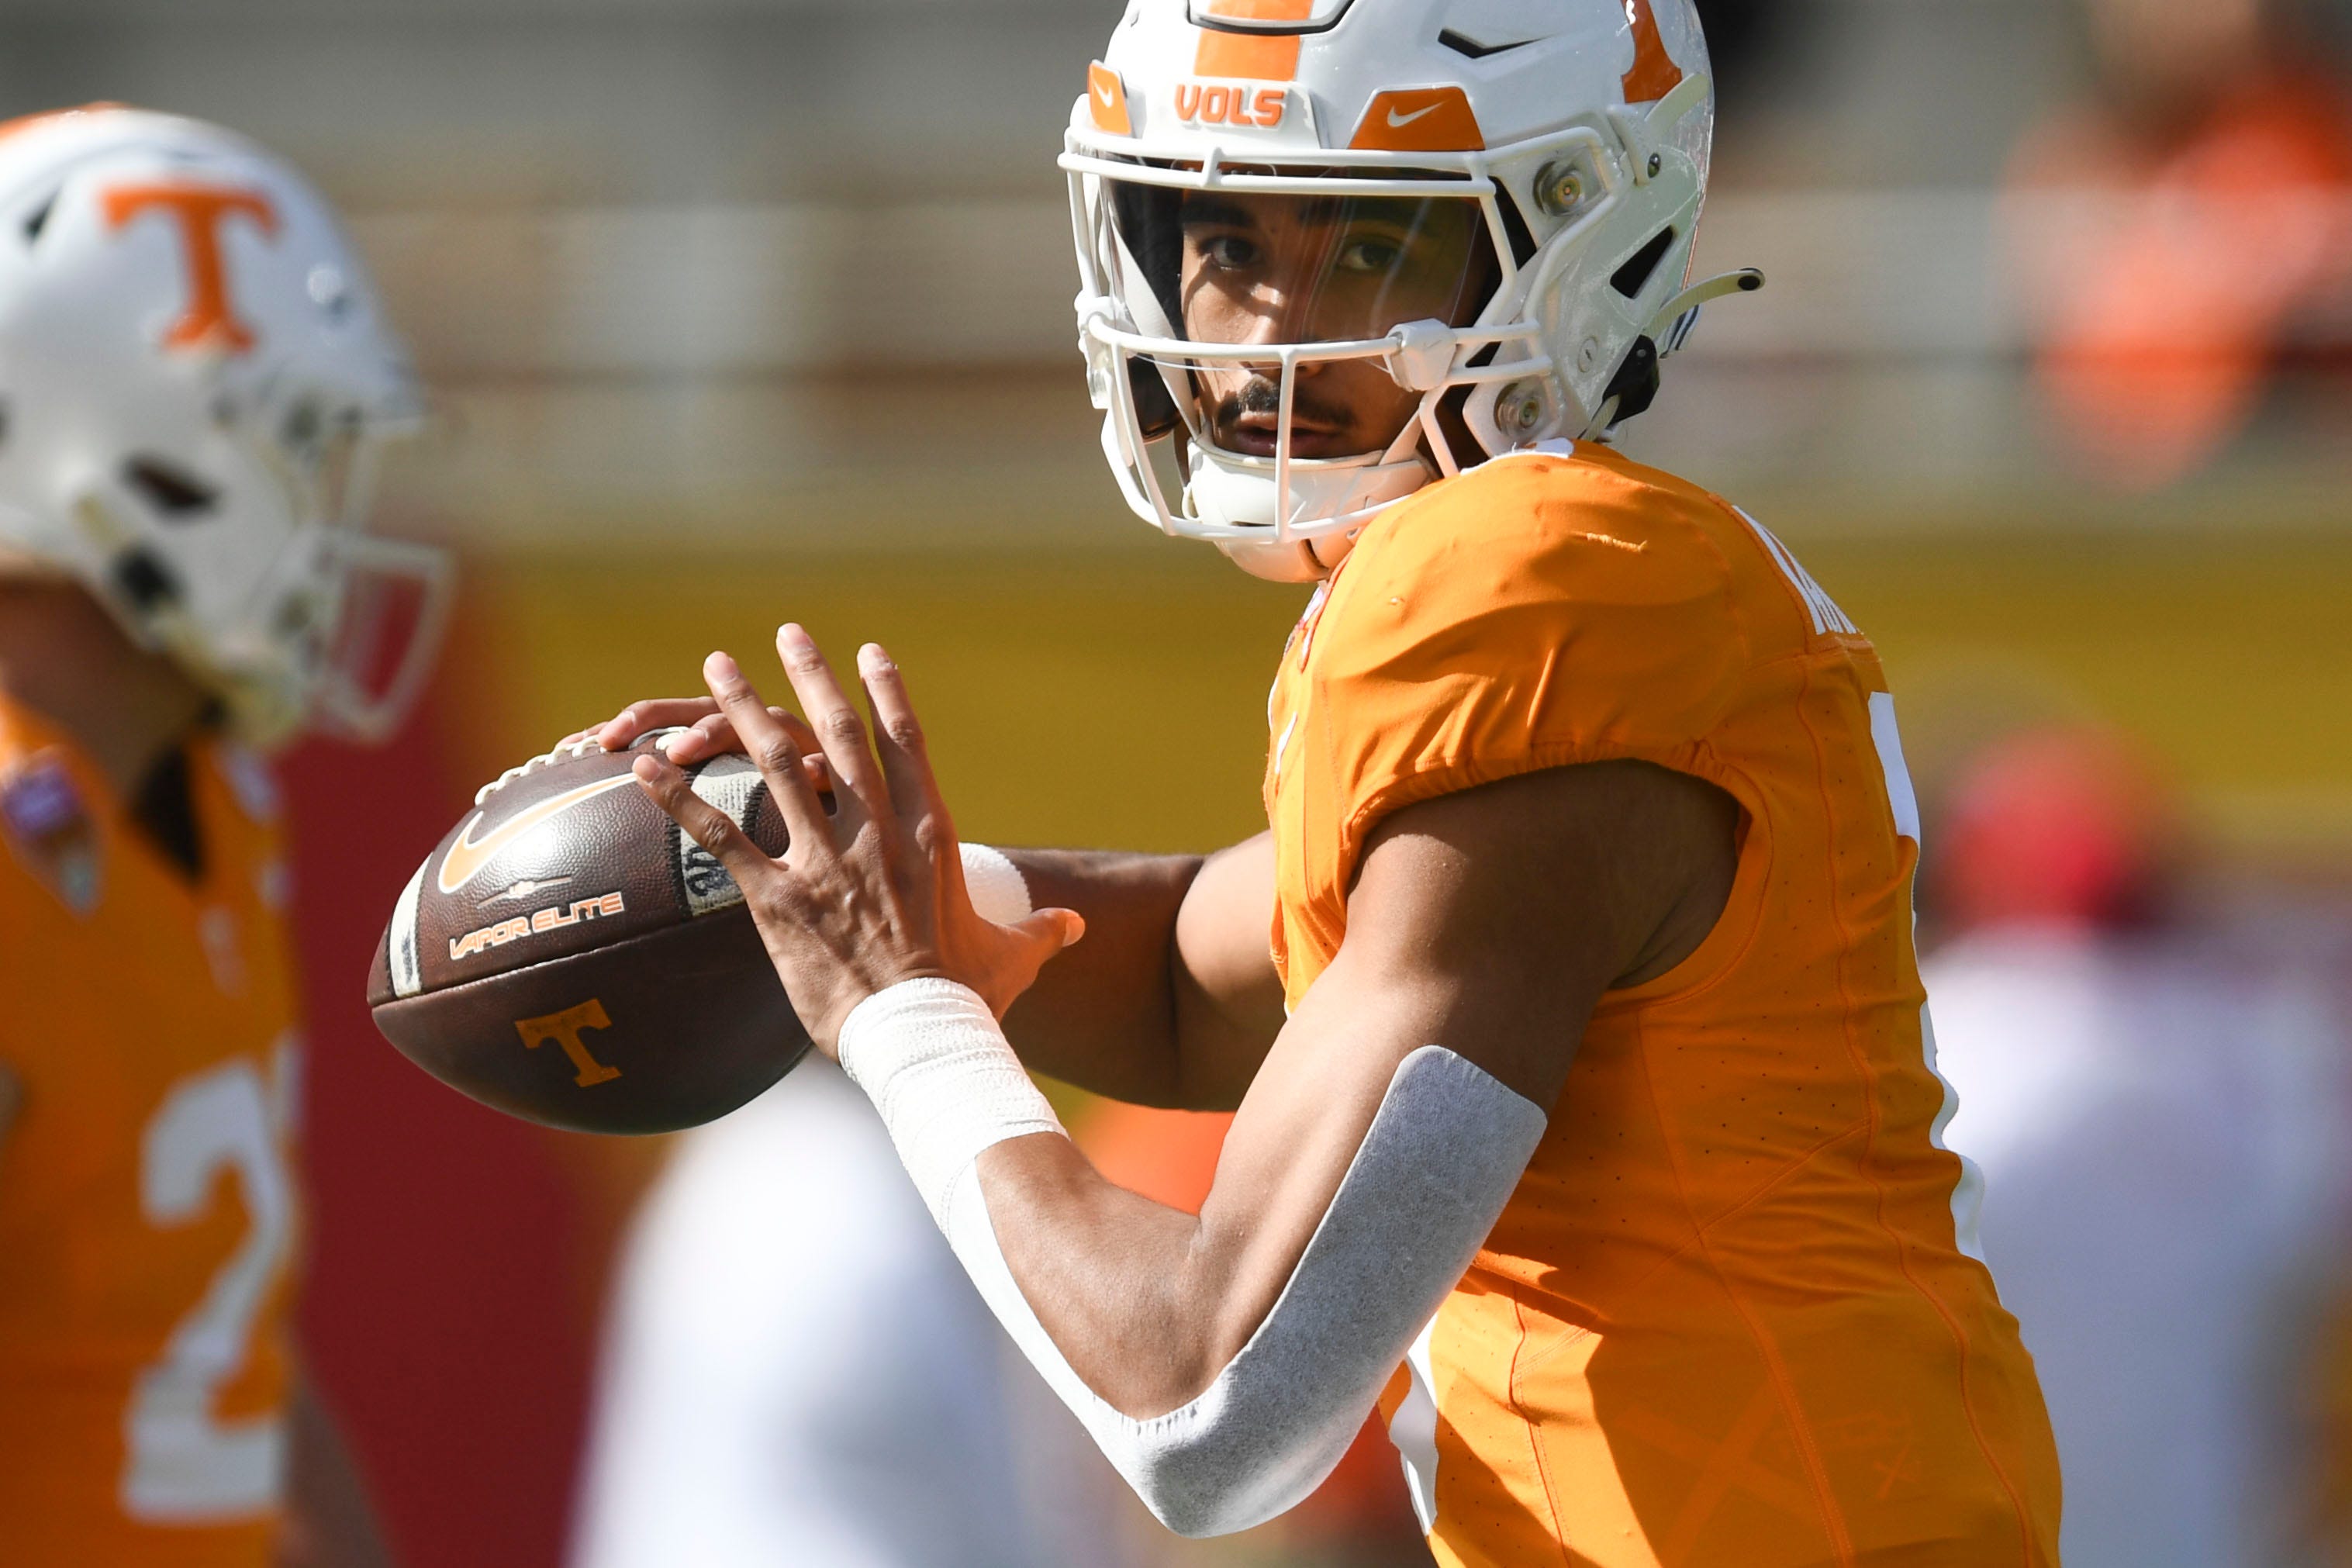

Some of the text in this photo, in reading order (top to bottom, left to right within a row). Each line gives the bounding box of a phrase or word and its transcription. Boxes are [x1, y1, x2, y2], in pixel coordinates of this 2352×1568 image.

[1173, 83, 1285, 127] VOLS
[99, 183, 281, 354] T
[449, 916, 531, 961] VAPOR
[530, 891, 625, 933] ELITE
[514, 997, 623, 1087] T
[119, 1031, 302, 1526] 2
